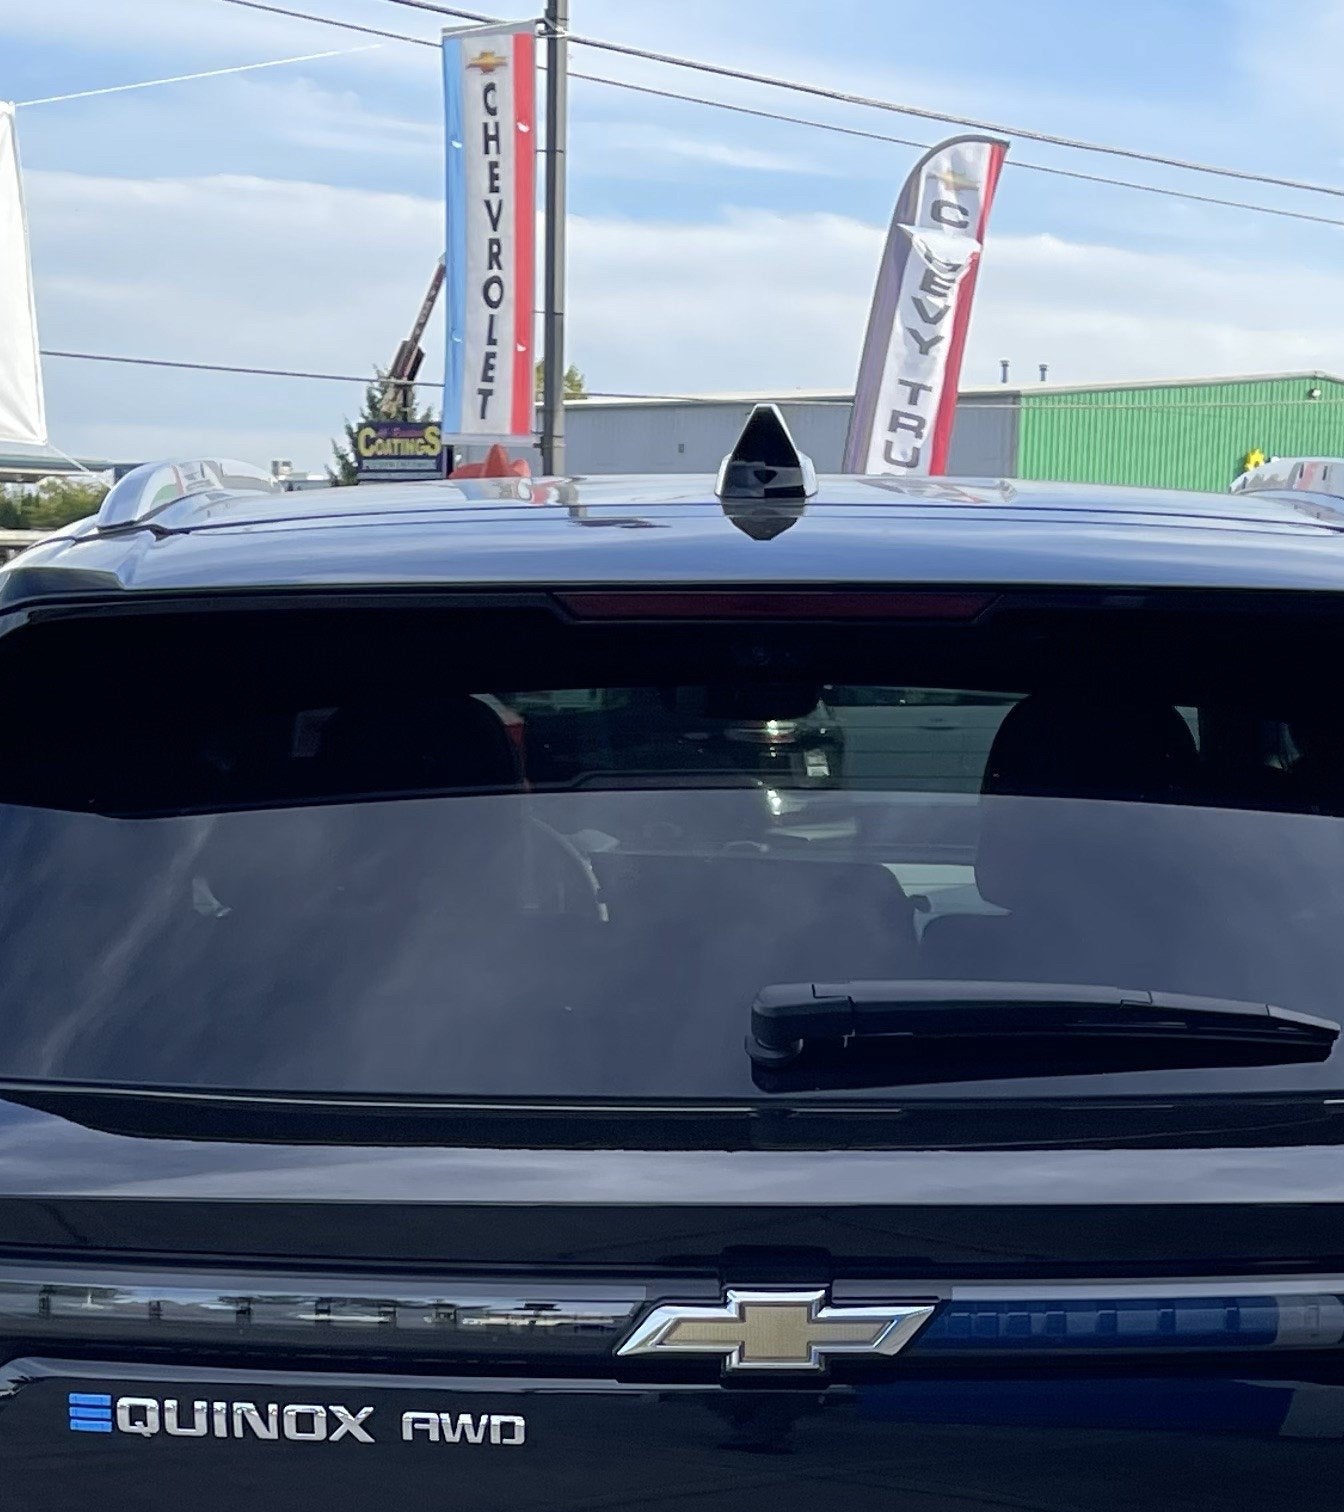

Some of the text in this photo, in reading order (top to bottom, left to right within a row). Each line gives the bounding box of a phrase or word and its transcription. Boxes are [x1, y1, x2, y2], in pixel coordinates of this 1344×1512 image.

[477, 82, 504, 420] CHEVROLET
[882, 378, 932, 475] TRU
[69, 1393, 526, 1445] EQUINOX AWD
